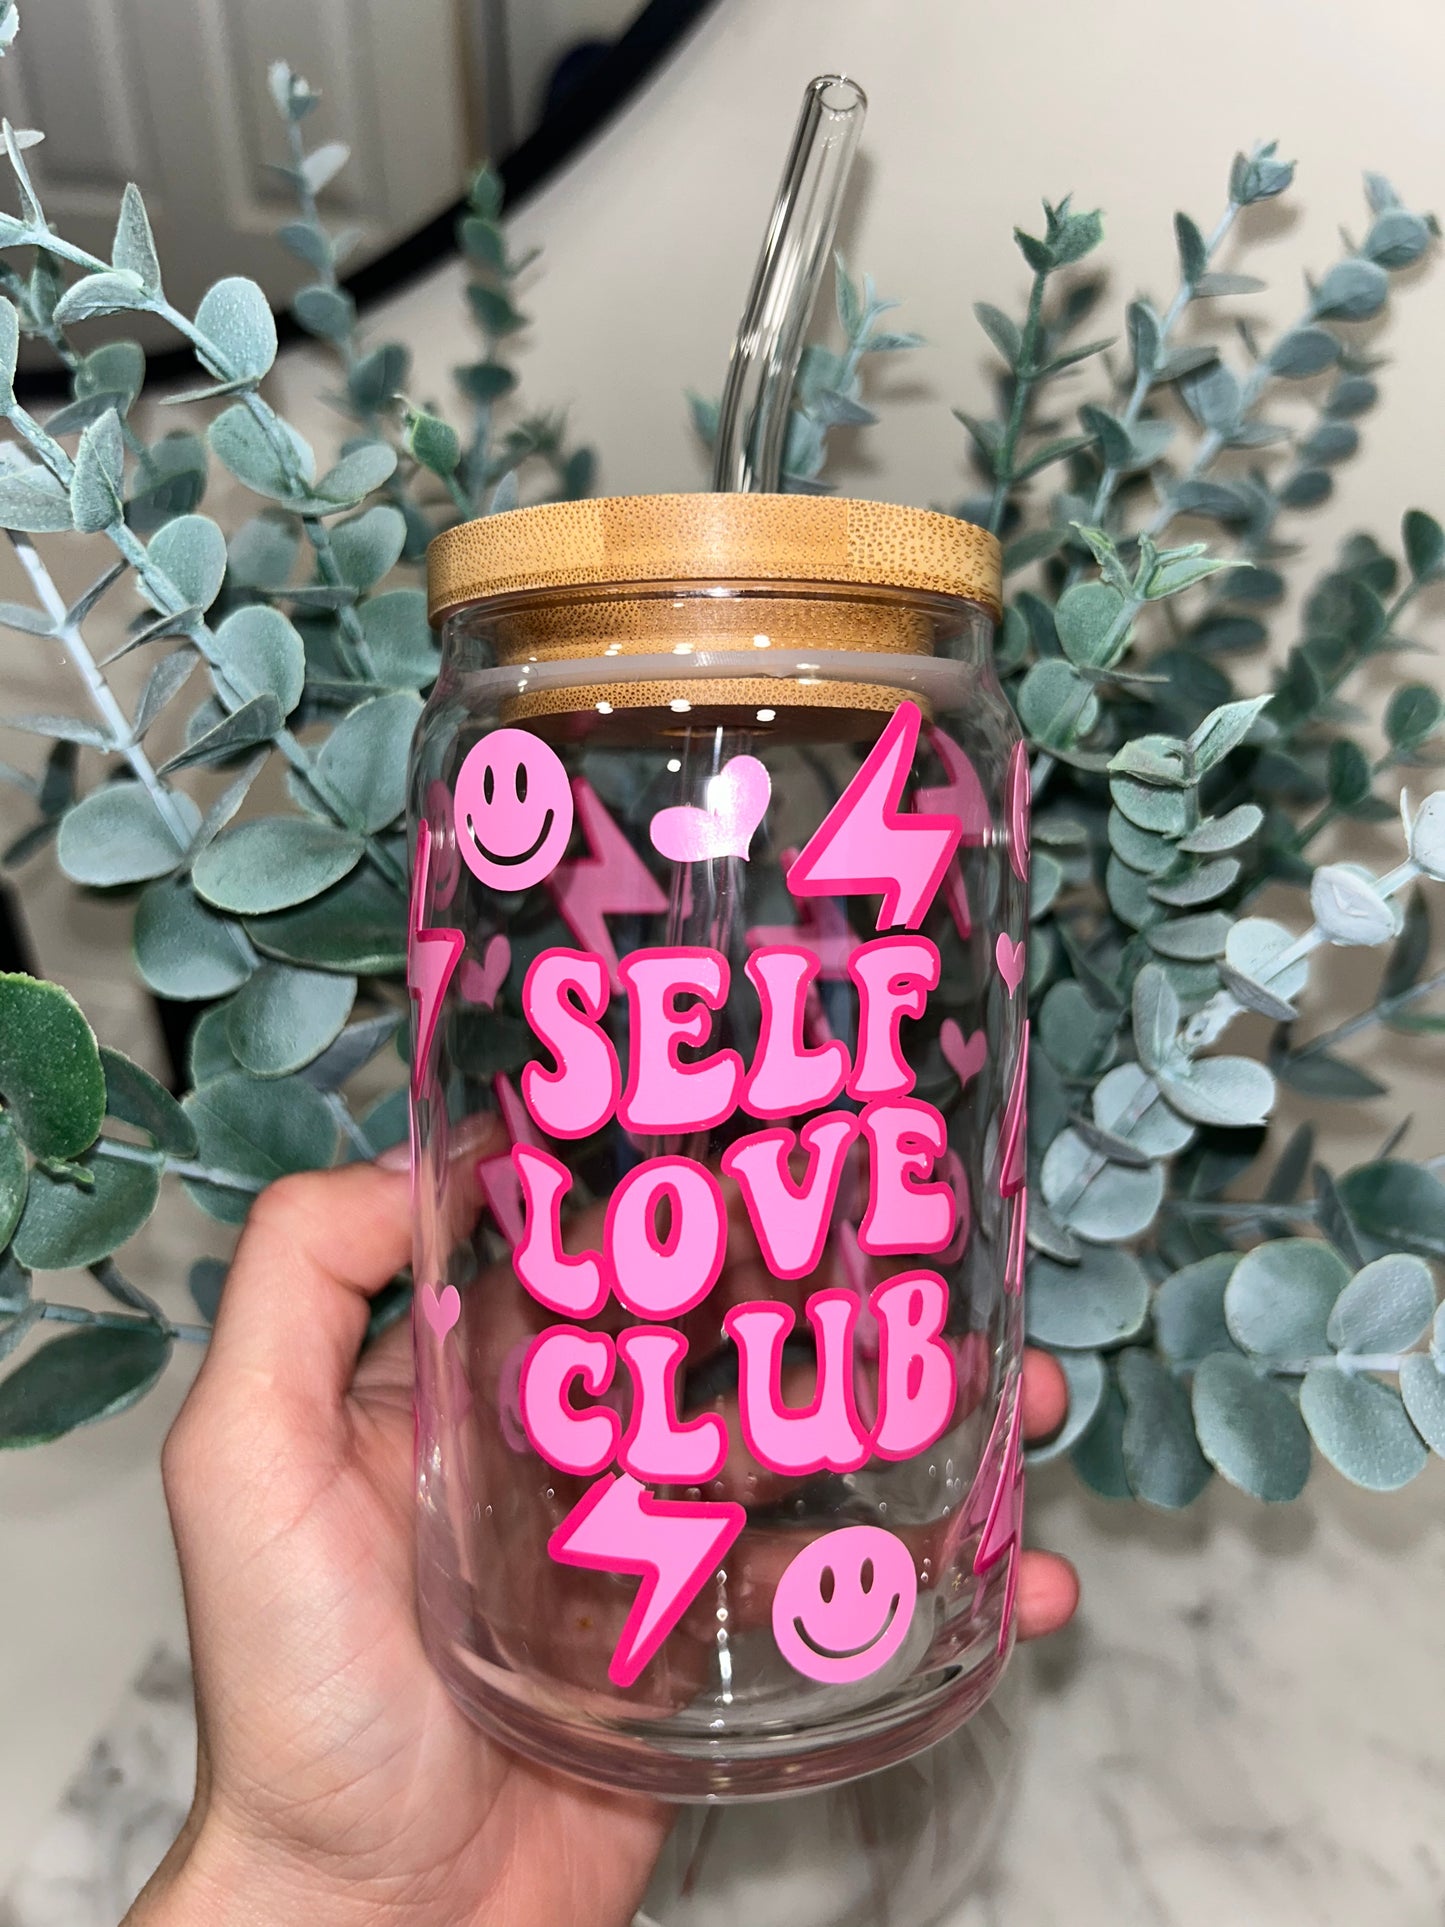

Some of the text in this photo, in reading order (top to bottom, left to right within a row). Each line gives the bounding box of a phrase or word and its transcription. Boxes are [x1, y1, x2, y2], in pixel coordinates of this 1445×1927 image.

[521, 935, 941, 1139] SELF
[512, 1097, 956, 1320] LOVE
[520, 1269, 957, 1484] CLUB
